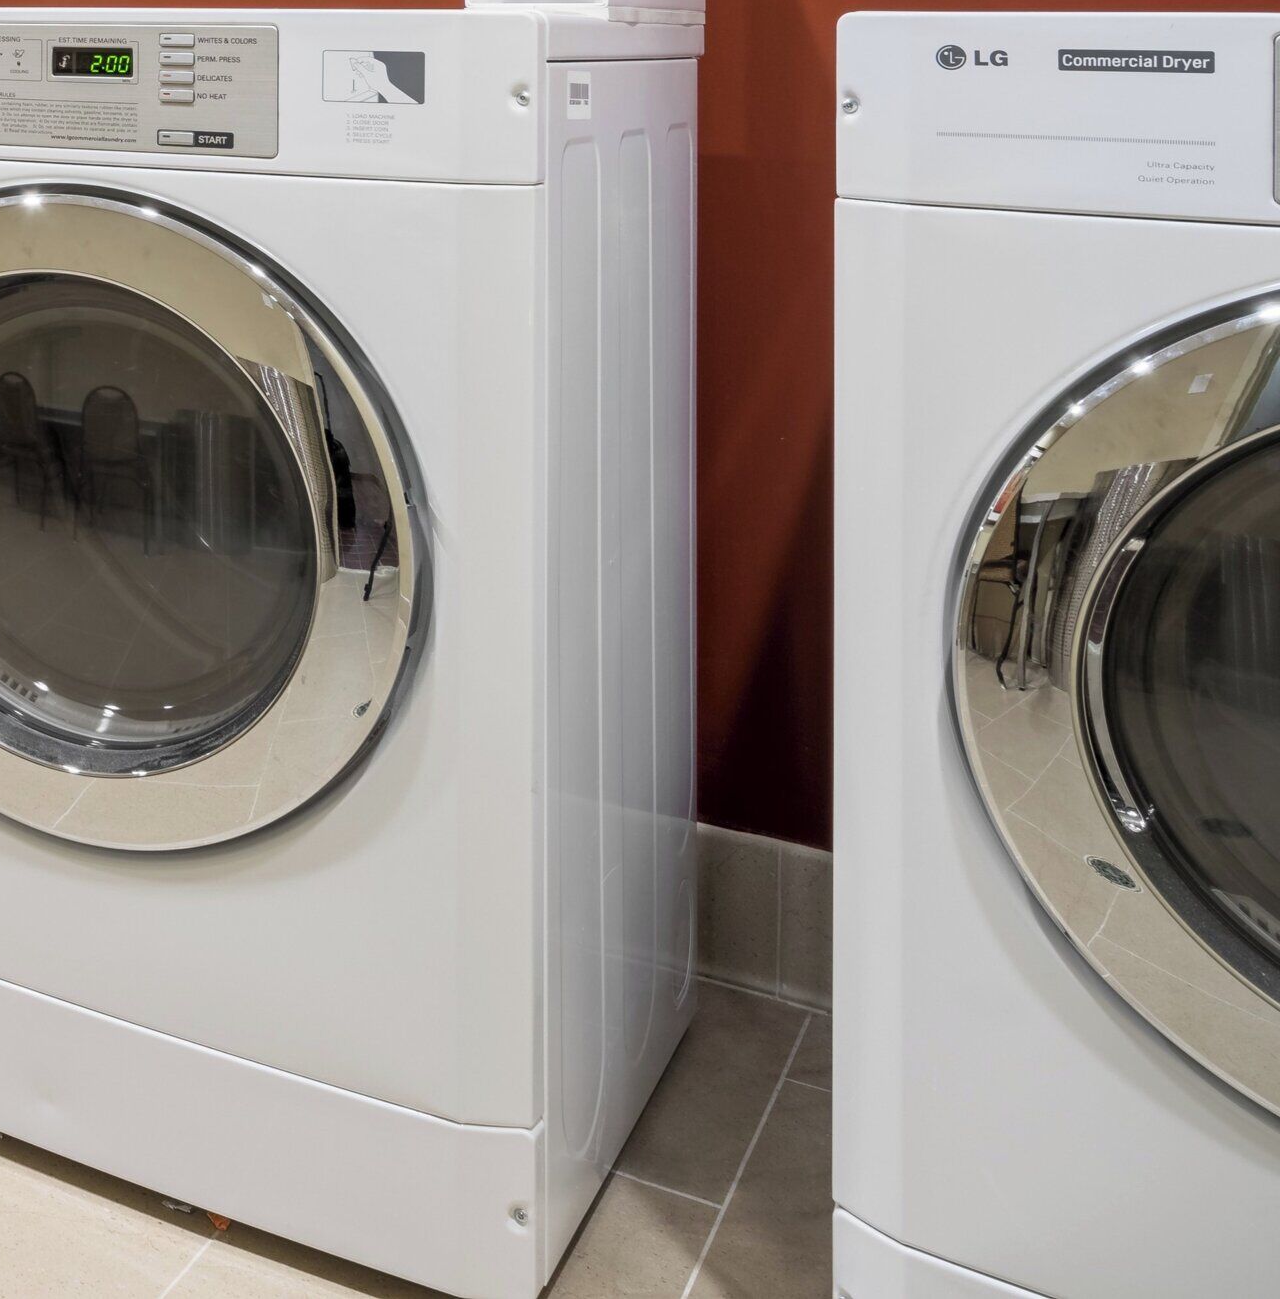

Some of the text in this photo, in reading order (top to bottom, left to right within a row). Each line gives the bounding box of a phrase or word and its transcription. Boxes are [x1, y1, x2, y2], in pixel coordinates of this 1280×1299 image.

[230, 37, 258, 45] COLORS
[219, 56, 241, 64] PRESS
[974, 50, 1009, 67] LG
[1061, 53, 1210, 72] Commercial Dryer
[196, 74, 233, 82] DELICATES
[209, 93, 228, 101] HEAT
[50, 134, 137, 144] www.lgcommerciallaundry.com
[198, 135, 228, 145] START
[1146, 160, 1216, 172] Ultra Capacity
[1137, 174, 1216, 186] Quiet Operation
